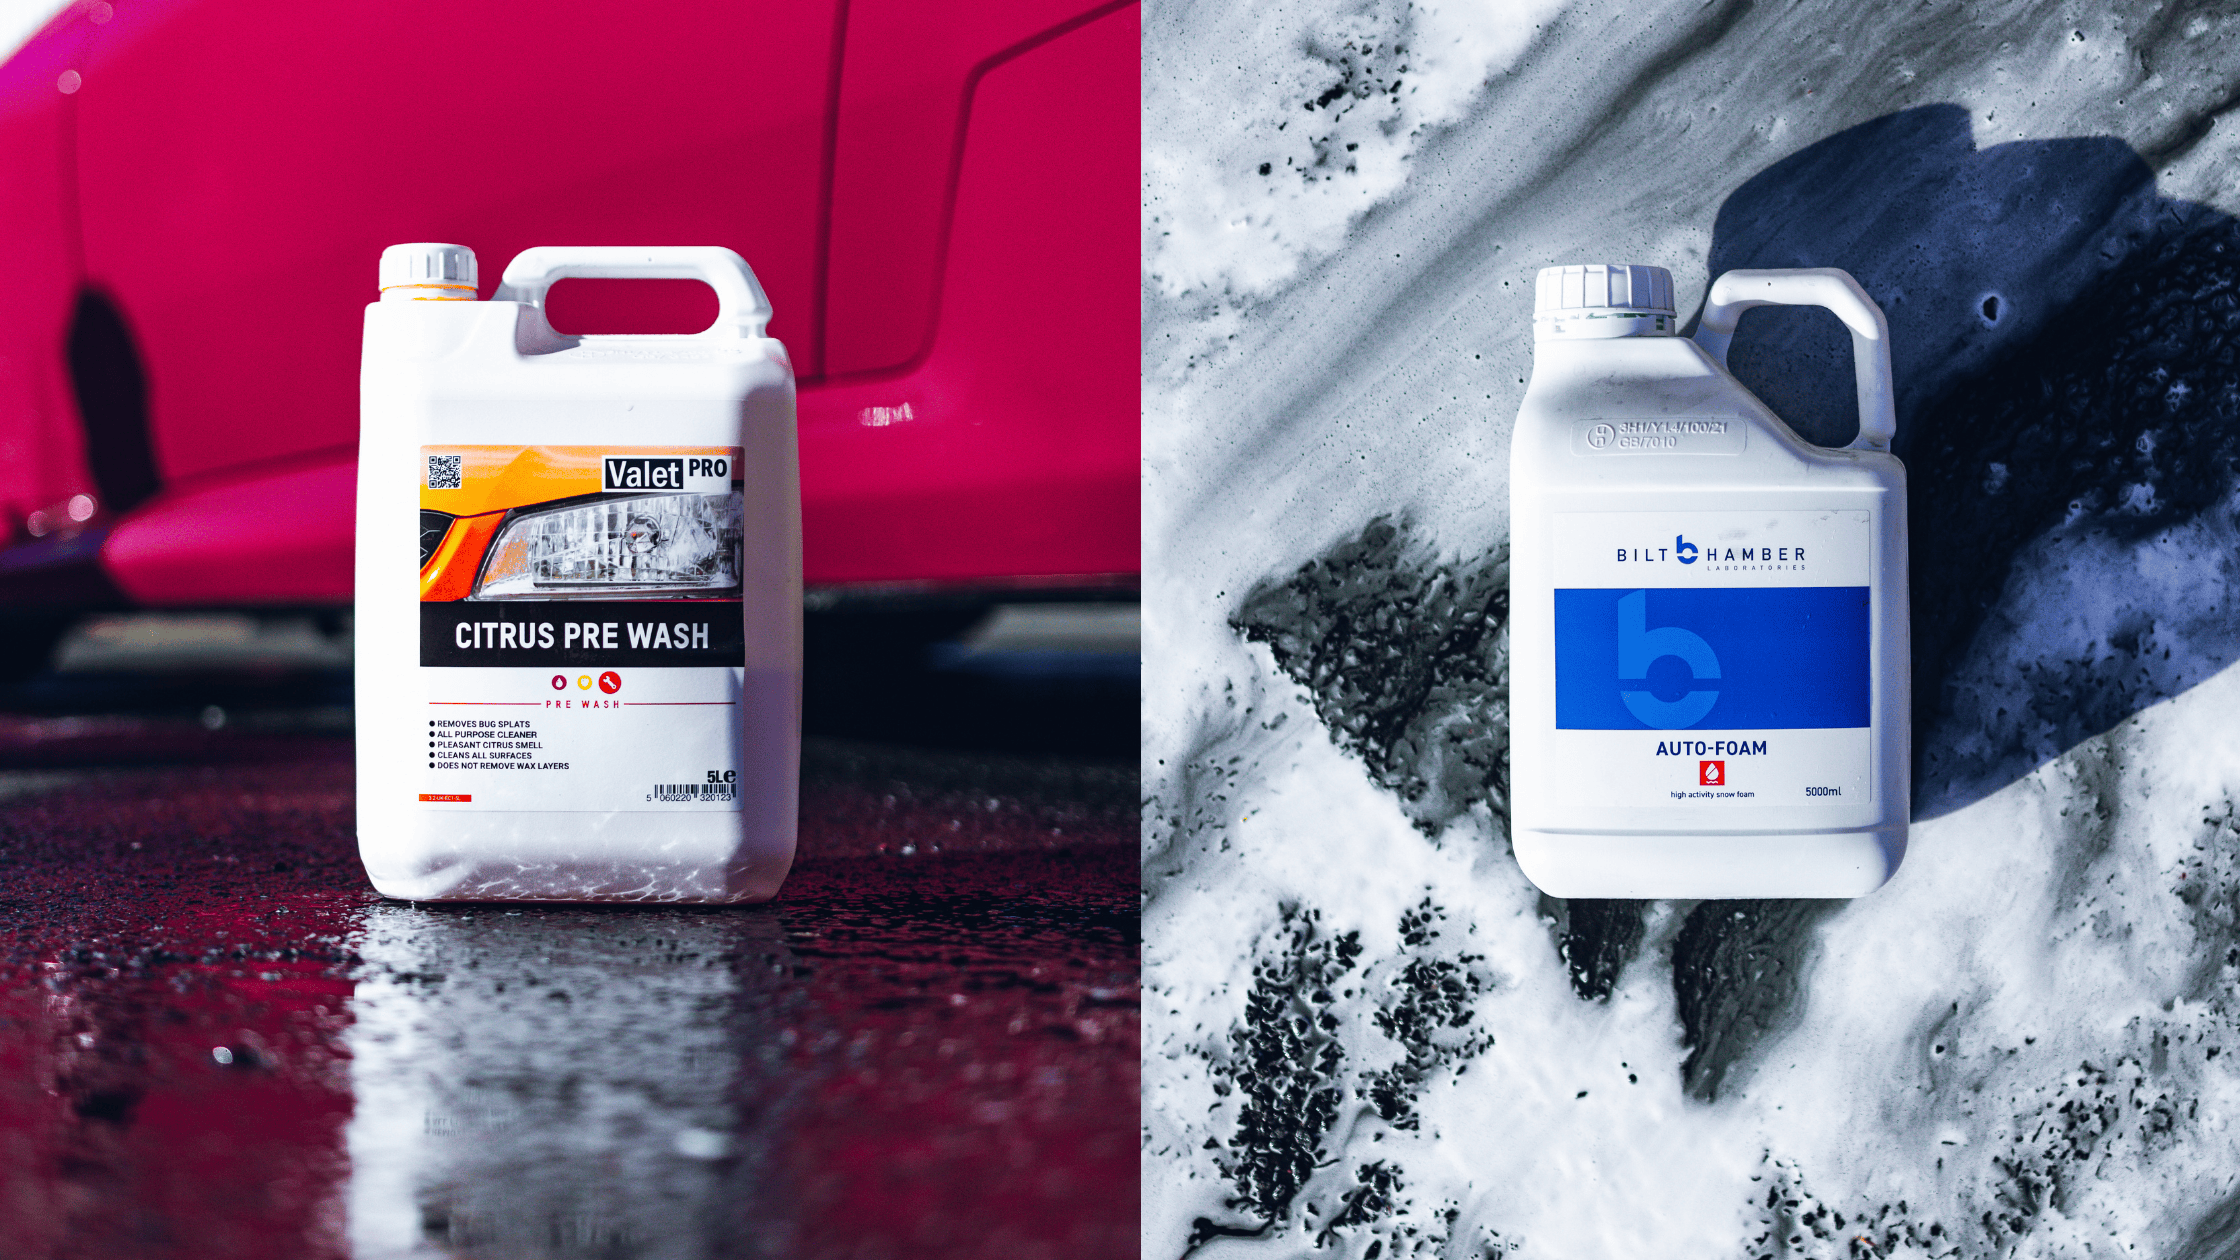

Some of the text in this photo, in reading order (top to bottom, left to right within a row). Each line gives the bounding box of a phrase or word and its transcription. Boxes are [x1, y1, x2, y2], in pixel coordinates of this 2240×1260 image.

[1618, 436, 1677, 449] GB/7010
[607, 458, 728, 488] Valet PRO
[1617, 548, 1668, 562] BILT
[1707, 547, 1806, 562] HAMBER
[1706, 564, 1807, 572] LABORATORIES
[455, 621, 710, 650] CITRUS PRE WASH
[545, 699, 620, 709] PRE WASH
[437, 720, 531, 728] REMOVES BUG SPLATS
[437, 731, 538, 739] ALL PURPOSE CLEANER
[437, 741, 543, 749] PLEASANT CITRUS SMELL
[1656, 740, 1768, 756] AUTO-FOAM
[437, 752, 532, 760] CLEANS ALL SURFACES
[437, 762, 570, 770] DOES NOT REMOVE WAX LAYERS
[1670, 791, 1755, 799] high activity snow foam
[1805, 786, 1842, 797] 5000ml
[646, 793, 732, 802] 5 060220 320123
